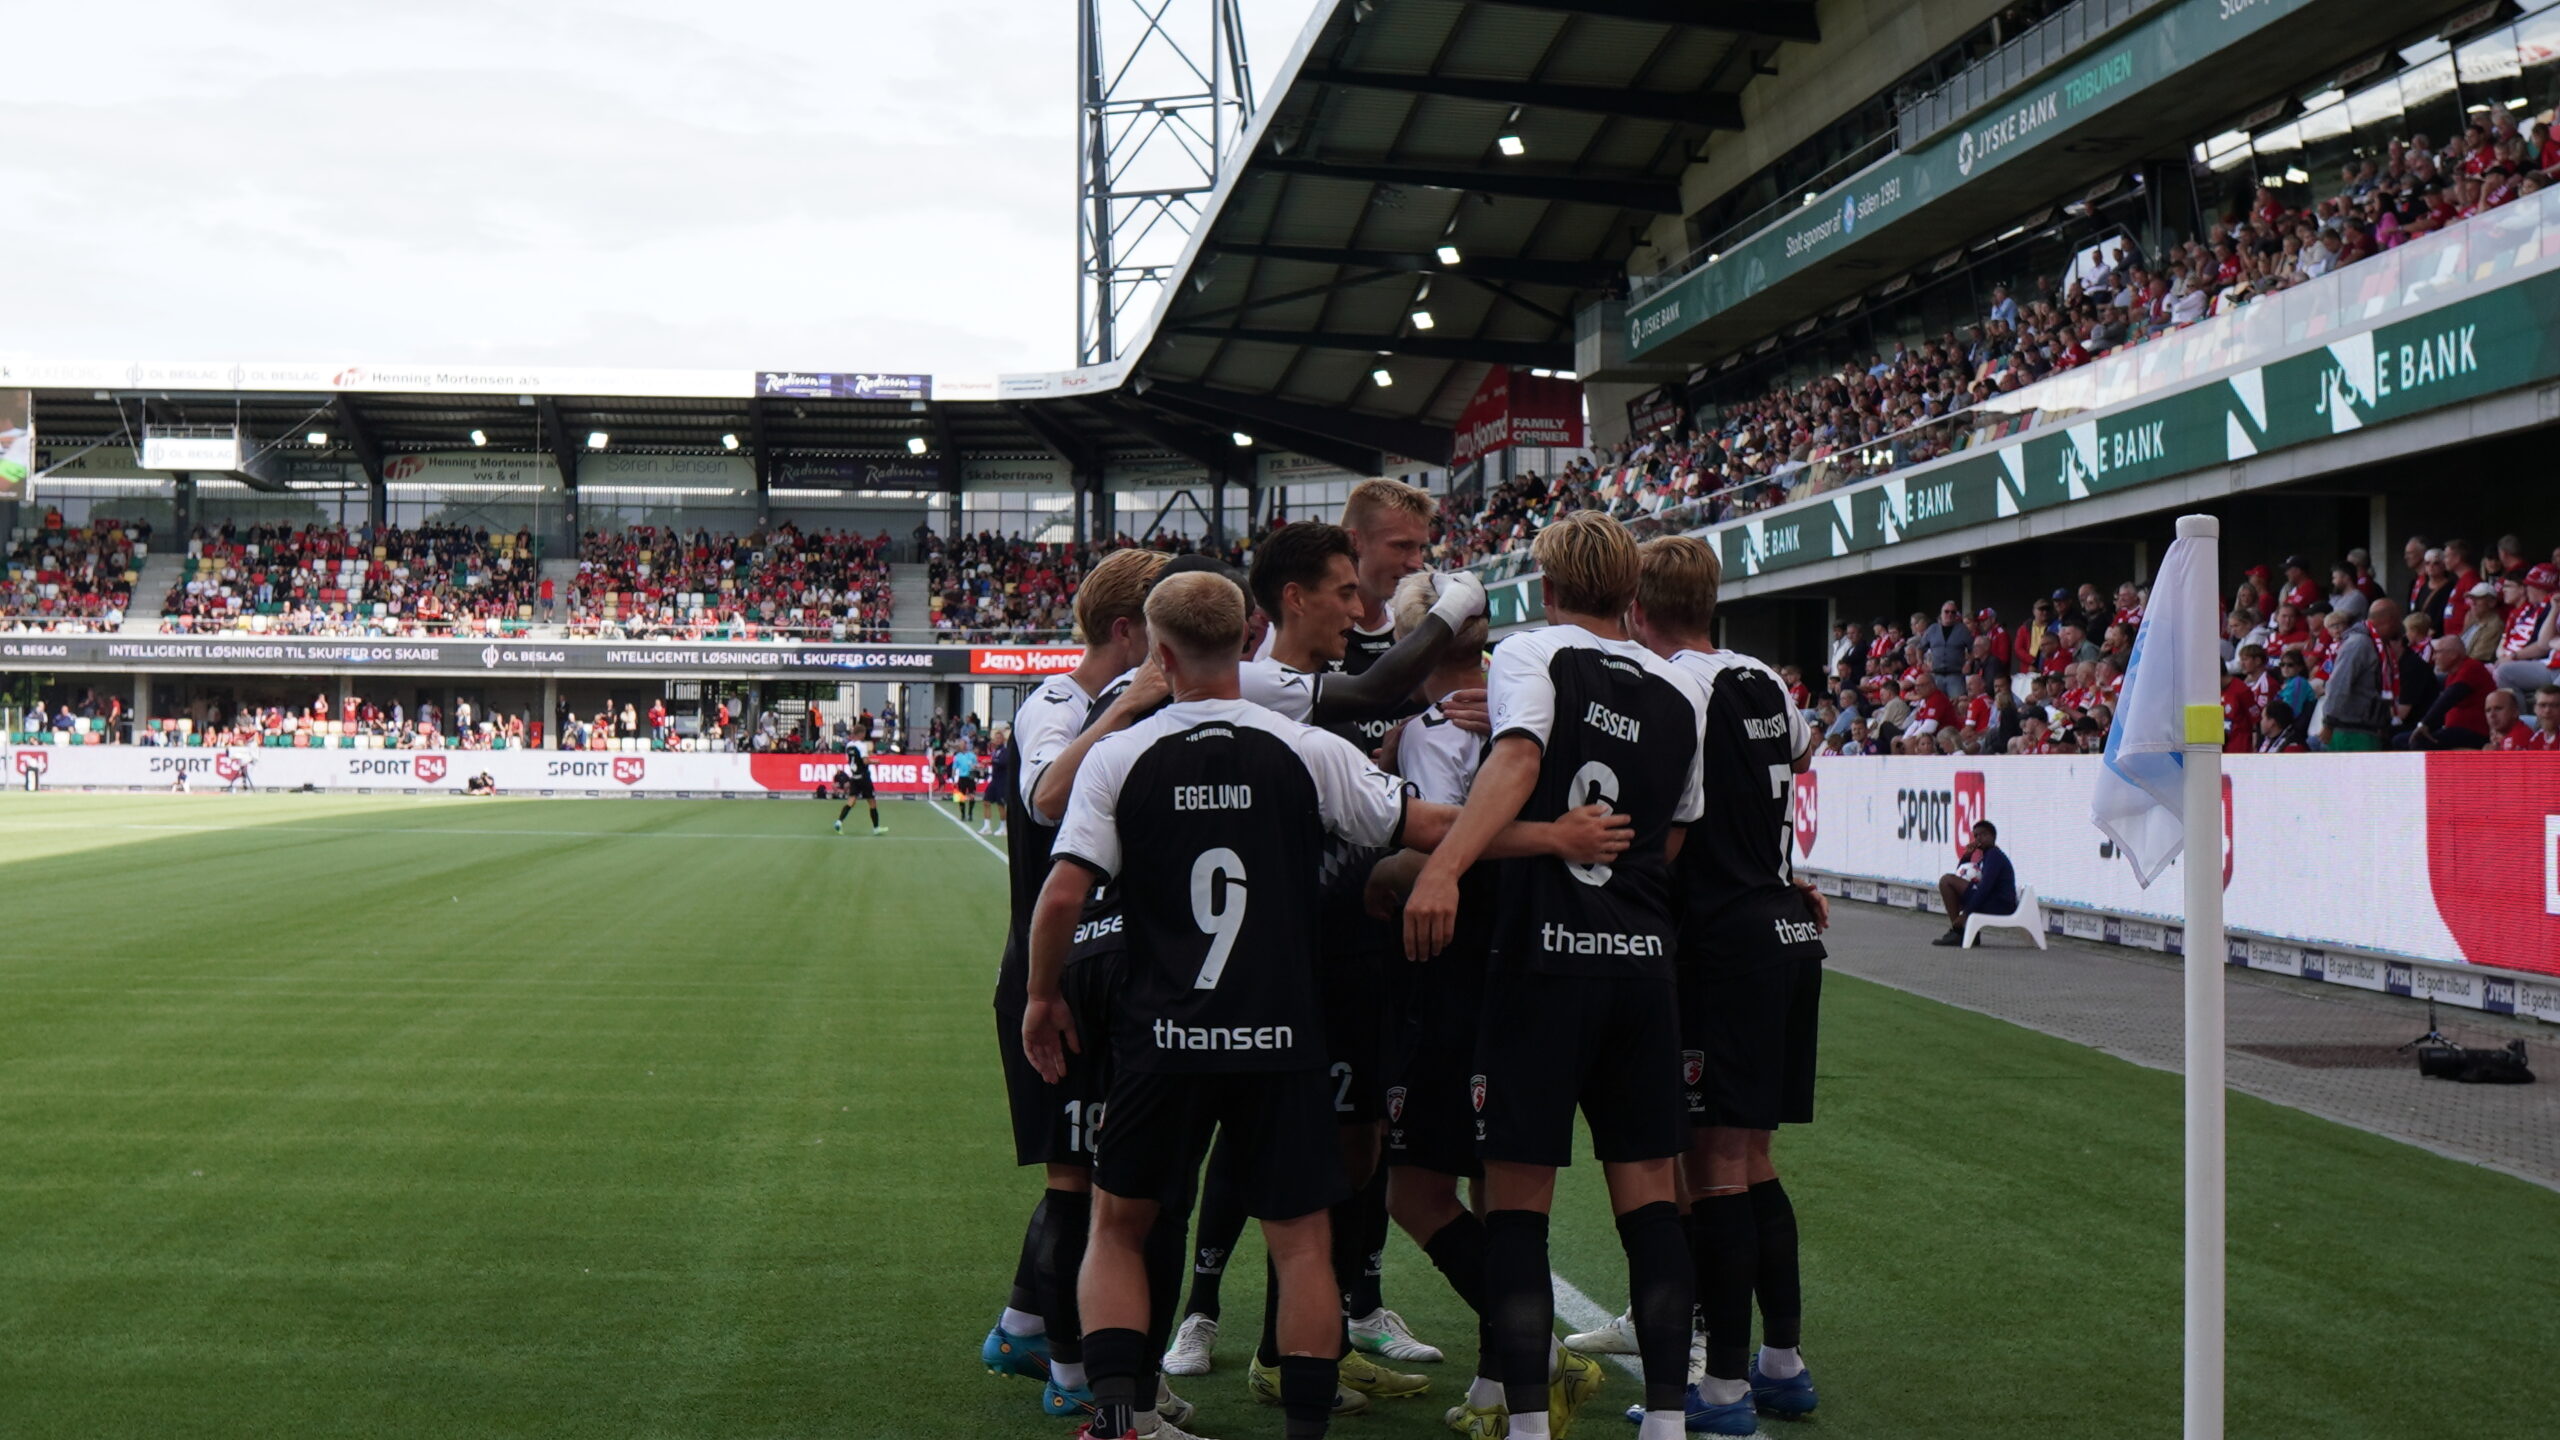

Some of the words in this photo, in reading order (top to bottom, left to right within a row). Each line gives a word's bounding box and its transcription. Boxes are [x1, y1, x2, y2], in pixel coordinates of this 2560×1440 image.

[1977, 115, 2016, 159] JYSKE
[2019, 91, 2058, 135] BANK
[2064, 49, 2132, 109] TRIBUNEN
[1803, 219, 1832, 252] sponsor
[1857, 192, 1880, 219] siden
[1880, 177, 1901, 207] 1991
[1641, 312, 1660, 339] JYSKE
[1661, 300, 1680, 327] BANK
[2401, 323, 2478, 390] BANK
[372, 372, 431, 387] Henning
[437, 373, 513, 386] Mortensen
[519, 373, 541, 387] a/s
[765, 373, 819, 393] Radisson
[855, 374, 909, 394] Radisson
[1512, 417, 1565, 429] FAMILY
[1512, 431, 1569, 442] CORNER
[2114, 420, 2164, 469] BANK
[429, 457, 476, 471] Henning
[481, 458, 547, 469] Mortensen
[607, 456, 657, 474] Søren
[665, 456, 728, 474] Jensen
[474, 473, 494, 481] vvs
[1917, 481, 1954, 520] BANK
[1772, 524, 1801, 555] BANK
[5, 645, 20, 656] OL
[22, 645, 67, 656] BESLAG
[109, 645, 202, 658] INTELLIGENTE
[205, 645, 282, 659] LØSNINGER
[286, 647, 305, 659] TIL
[308, 647, 369, 661] SKUFFER
[371, 648, 392, 660] OG
[395, 648, 439, 660] SKABE
[503, 651, 518, 662] OL
[520, 651, 565, 662] BESLAG
[607, 651, 699, 664] INTELLIGENTE
[702, 651, 778, 665] LØSNINGER
[781, 653, 801, 665] TIL
[803, 653, 864, 666] SKUFFER
[865, 653, 887, 666] OG
[889, 654, 933, 667] SKABE
[980, 652, 1024, 671] Jens
[1583, 700, 1641, 744] JESSEN
[150, 758, 211, 773] SPORT
[349, 759, 411, 775] SPORT
[418, 759, 445, 776] 24
[547, 761, 609, 777] SPORT
[616, 760, 644, 777] 24
[1174, 785, 1252, 811] EGELUND
[1797, 785, 1816, 833] 24
[1768, 763, 1793, 887] 7
[1897, 788, 1952, 844] SPORT
[1190, 847, 1248, 990] 9
[1541, 922, 1664, 957] thansen
[1774, 918, 1820, 944] thans
[2427, 974, 2444, 994] godt
[2446, 976, 2471, 996] tilbud
[2531, 990, 2551, 1012] godt
[1153, 1018, 1293, 1051] thansen
